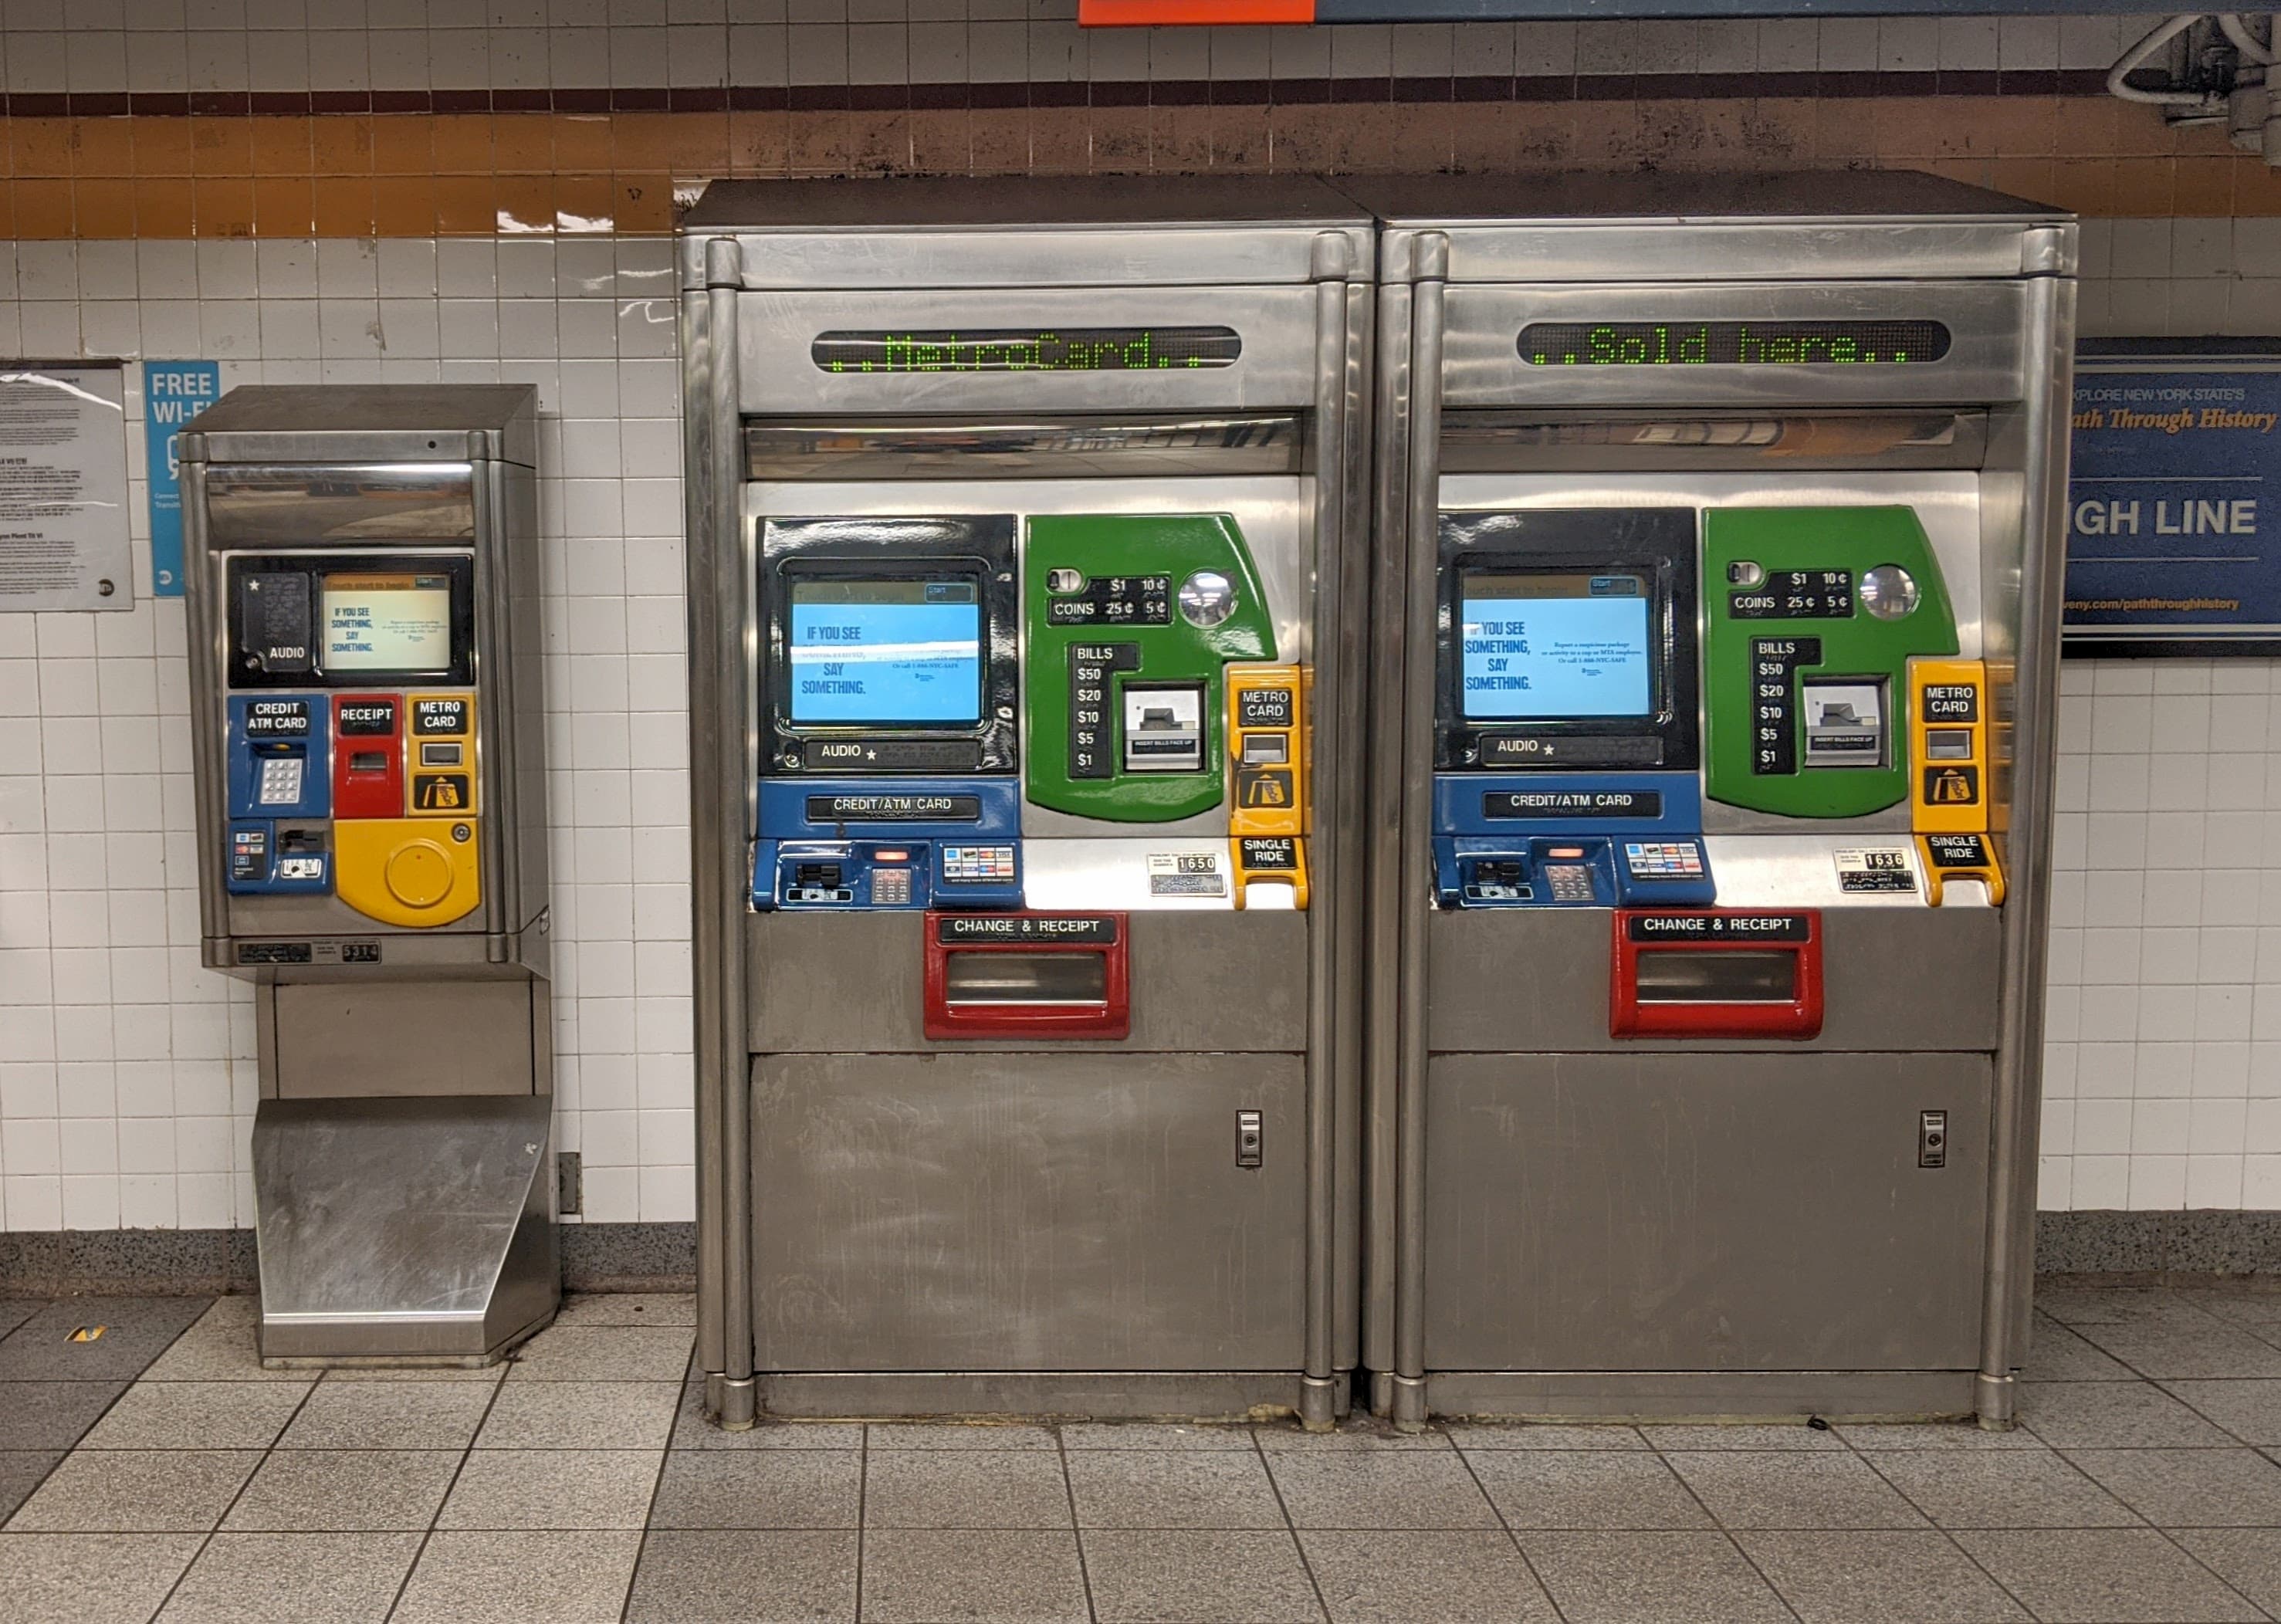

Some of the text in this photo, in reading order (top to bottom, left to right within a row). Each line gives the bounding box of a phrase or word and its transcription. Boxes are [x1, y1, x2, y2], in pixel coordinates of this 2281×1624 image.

[152, 374, 212, 395] FREE
[2124, 388, 2156, 401] NEW
[2157, 388, 2195, 401] YORK
[2195, 387, 2245, 401] STATE'S
[153, 401, 210, 423] WI-F
[2071, 407, 2277, 434] ath Through History
[2156, 499, 2257, 535] LINE
[1110, 579, 1126, 591] $1
[1791, 573, 1807, 585] $1
[1734, 597, 1775, 608] COINS
[335, 607, 371, 617] IF YOU SEE
[1054, 604, 1095, 615] COINS
[331, 619, 373, 629] SOMETHING,
[1481, 621, 1504, 635] YOU
[1505, 621, 1525, 635] SEE
[345, 631, 359, 640] SAY
[807, 626, 861, 640] IF YOU SEE
[270, 647, 304, 658] AUDIO
[332, 643, 374, 652] SOMETHING.
[1078, 648, 1113, 659] BILLS
[1465, 640, 1531, 655] SOMETHING,
[1758, 642, 1795, 655] BILLS
[823, 663, 844, 676] SAY
[1487, 658, 1508, 672] SAY
[1759, 663, 1784, 675] $50
[1078, 668, 1102, 681] $50
[801, 680, 866, 695] SOMETHING.
[1466, 676, 1532, 690] SOMETHING.
[1078, 689, 1102, 702] $20
[1760, 685, 1784, 697] $20
[1927, 687, 1974, 699] METRO
[1243, 692, 1289, 703] METRO
[255, 702, 300, 715] CREDIT
[420, 701, 461, 714] METRO
[1247, 705, 1284, 717] CARD
[1760, 706, 1782, 719] $10
[1931, 701, 1969, 713] CARD
[340, 709, 393, 721] RECEIPT
[1078, 710, 1099, 723] $10
[248, 716, 307, 729] ATM CARD
[425, 716, 456, 728] CARD
[1078, 732, 1095, 746] $5
[1760, 729, 1778, 741] $5
[821, 745, 861, 756] AUDIO
[1497, 740, 1538, 752] AUDIO
[1078, 753, 1092, 766] $1
[1761, 750, 1776, 763] $1
[834, 797, 952, 810] CREDIT/ATM CARD
[1511, 794, 1633, 807] CREDIT/ATM CARD
[1244, 839, 1291, 850] SINGLE
[1931, 836, 1979, 847] SINGLE
[1254, 851, 1285, 863] RIDE
[1866, 854, 1904, 865] 1636
[1944, 848, 1975, 859] RIDE
[1179, 858, 1215, 868] 1650
[954, 920, 1100, 933] CHANGE & RECEIPT
[1644, 918, 1792, 931] CHANGE & RECEIPT
